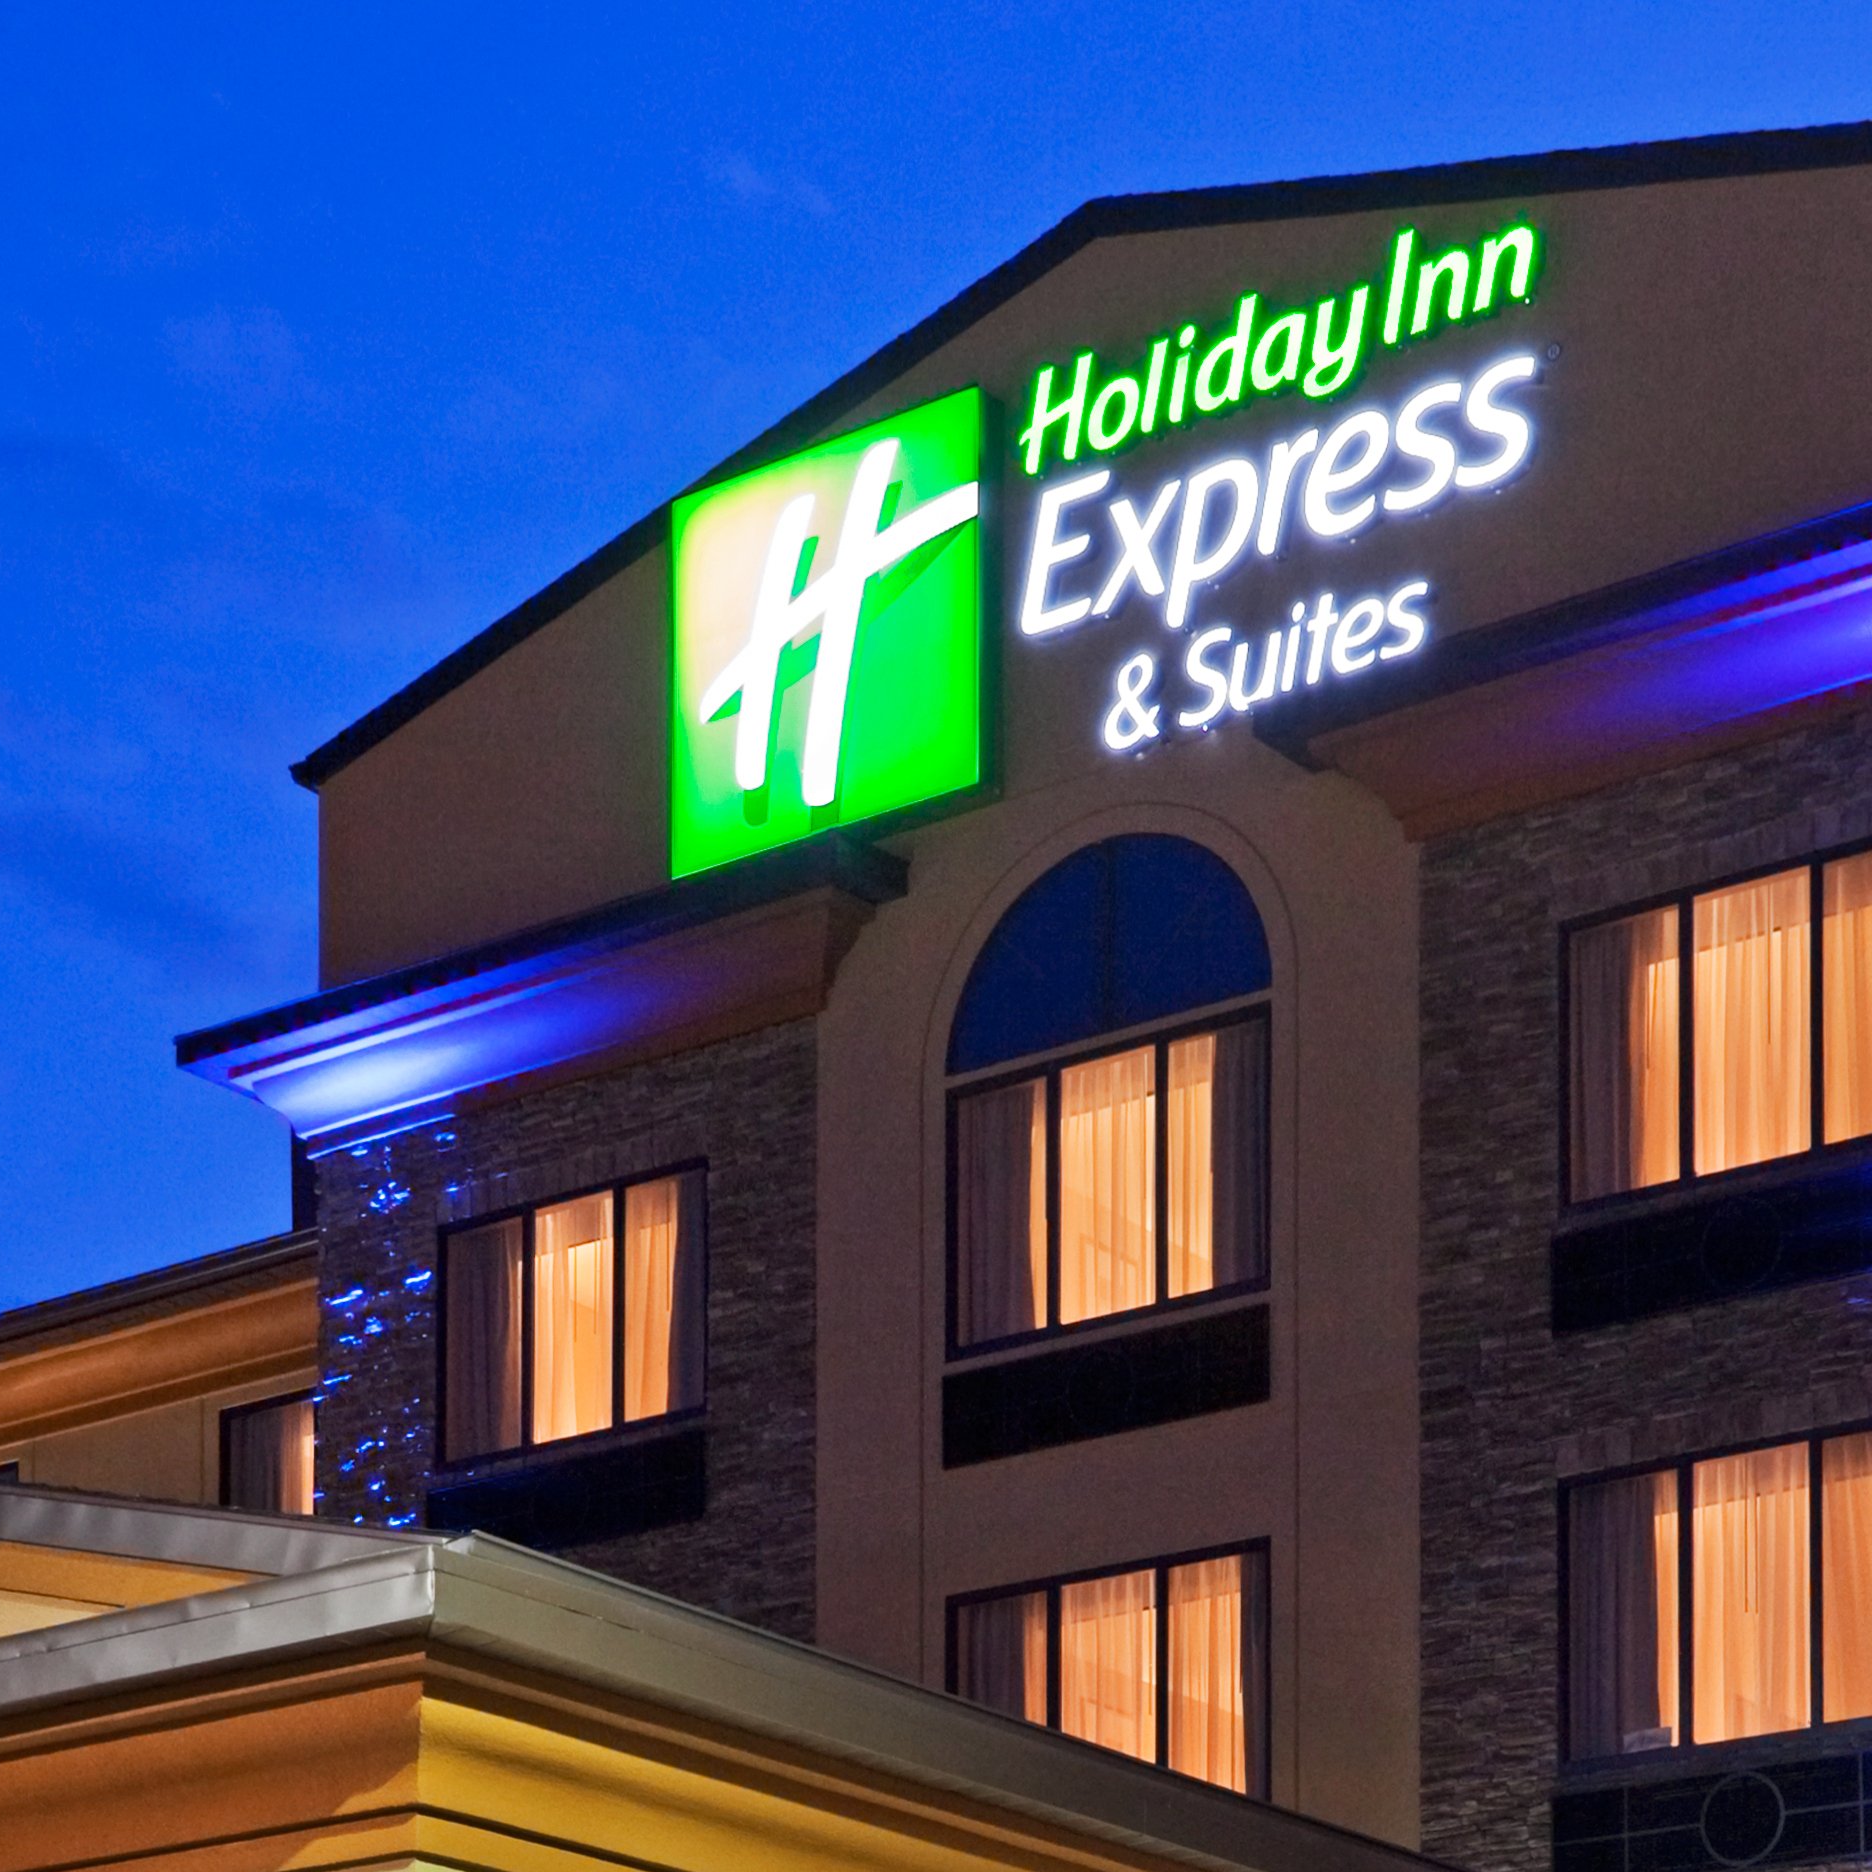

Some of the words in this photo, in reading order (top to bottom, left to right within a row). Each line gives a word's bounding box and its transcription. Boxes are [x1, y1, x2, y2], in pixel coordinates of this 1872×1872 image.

[1019, 290, 1370, 475] Holiday
[1383, 224, 1536, 346] Inn
[1018, 354, 1536, 637] Express
[1102, 652, 1162, 753] &
[1177, 581, 1430, 729] Suites
